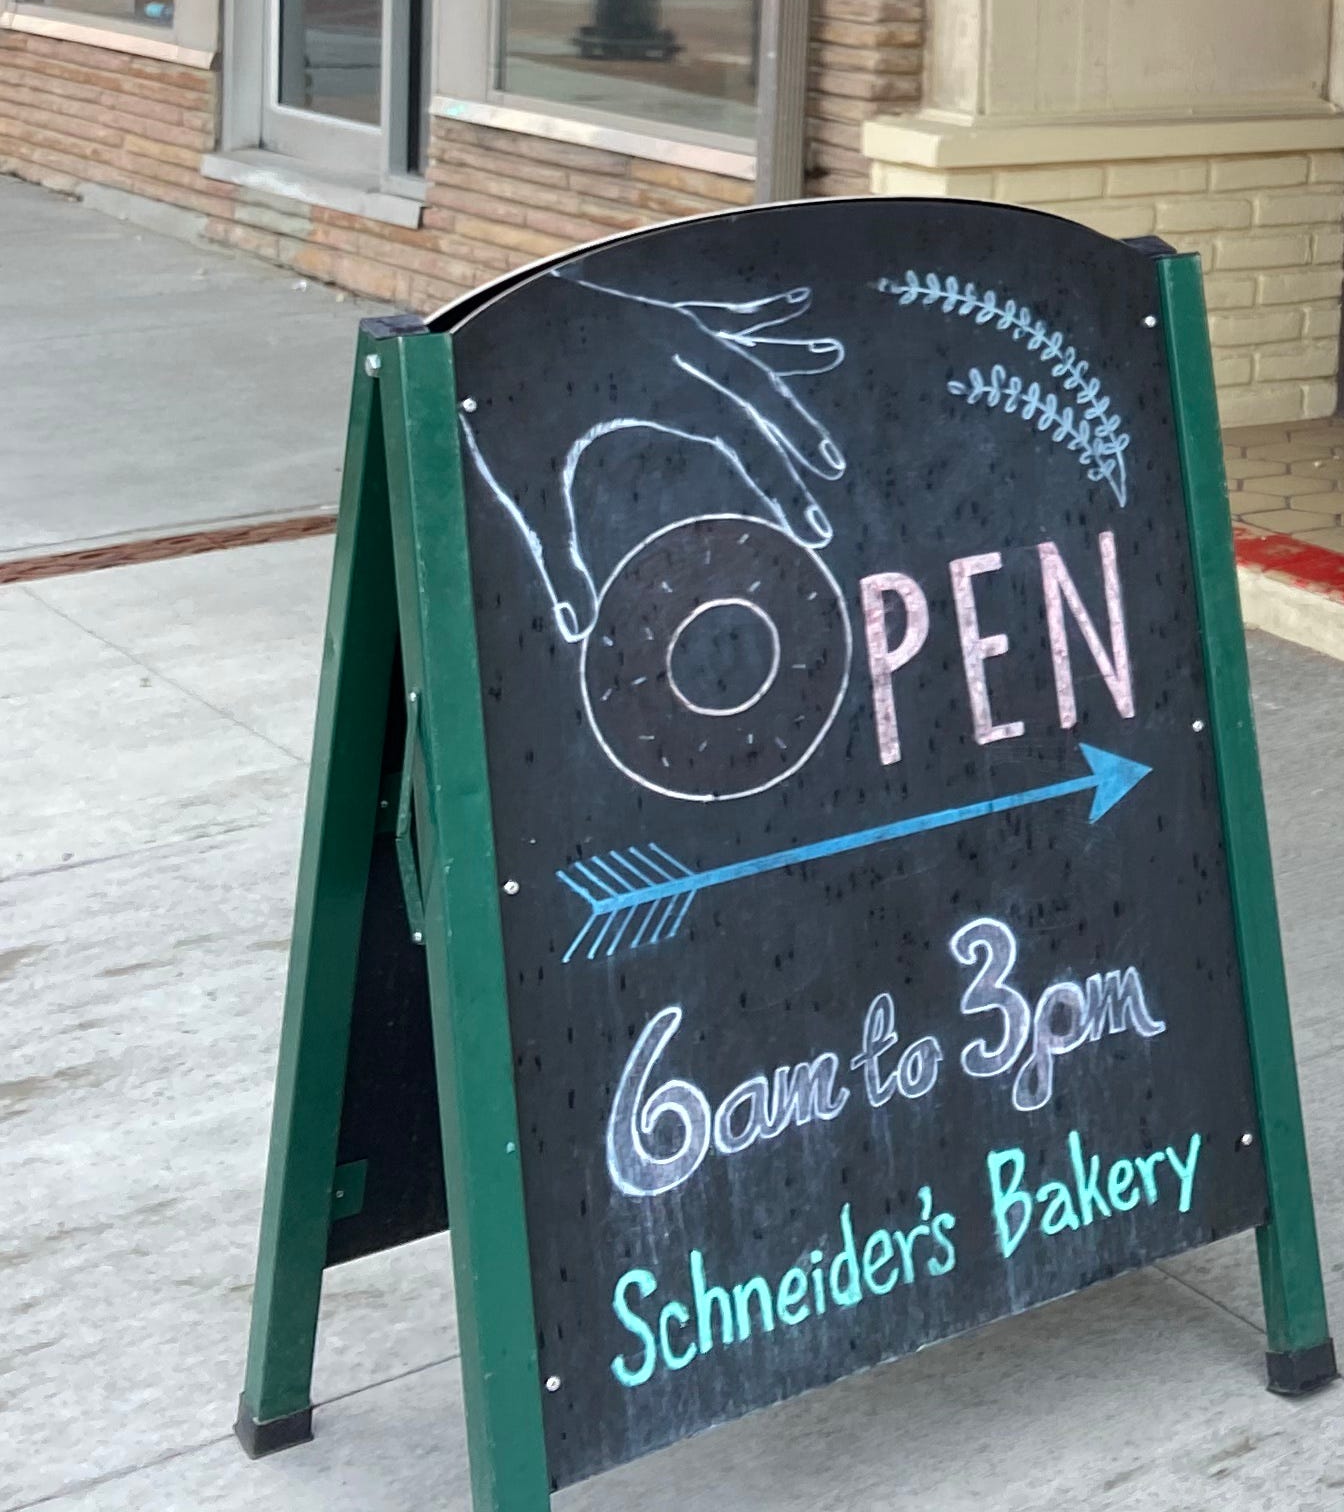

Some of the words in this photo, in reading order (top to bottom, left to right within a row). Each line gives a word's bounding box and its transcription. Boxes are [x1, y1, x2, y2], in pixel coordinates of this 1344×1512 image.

[606, 1005, 849, 1197] 6am
[850, 992, 942, 1108] to
[950, 917, 1165, 1112] 3pm
[611, 1185, 957, 1388] Schneider's
[987, 1130, 1200, 1259] Bakery
